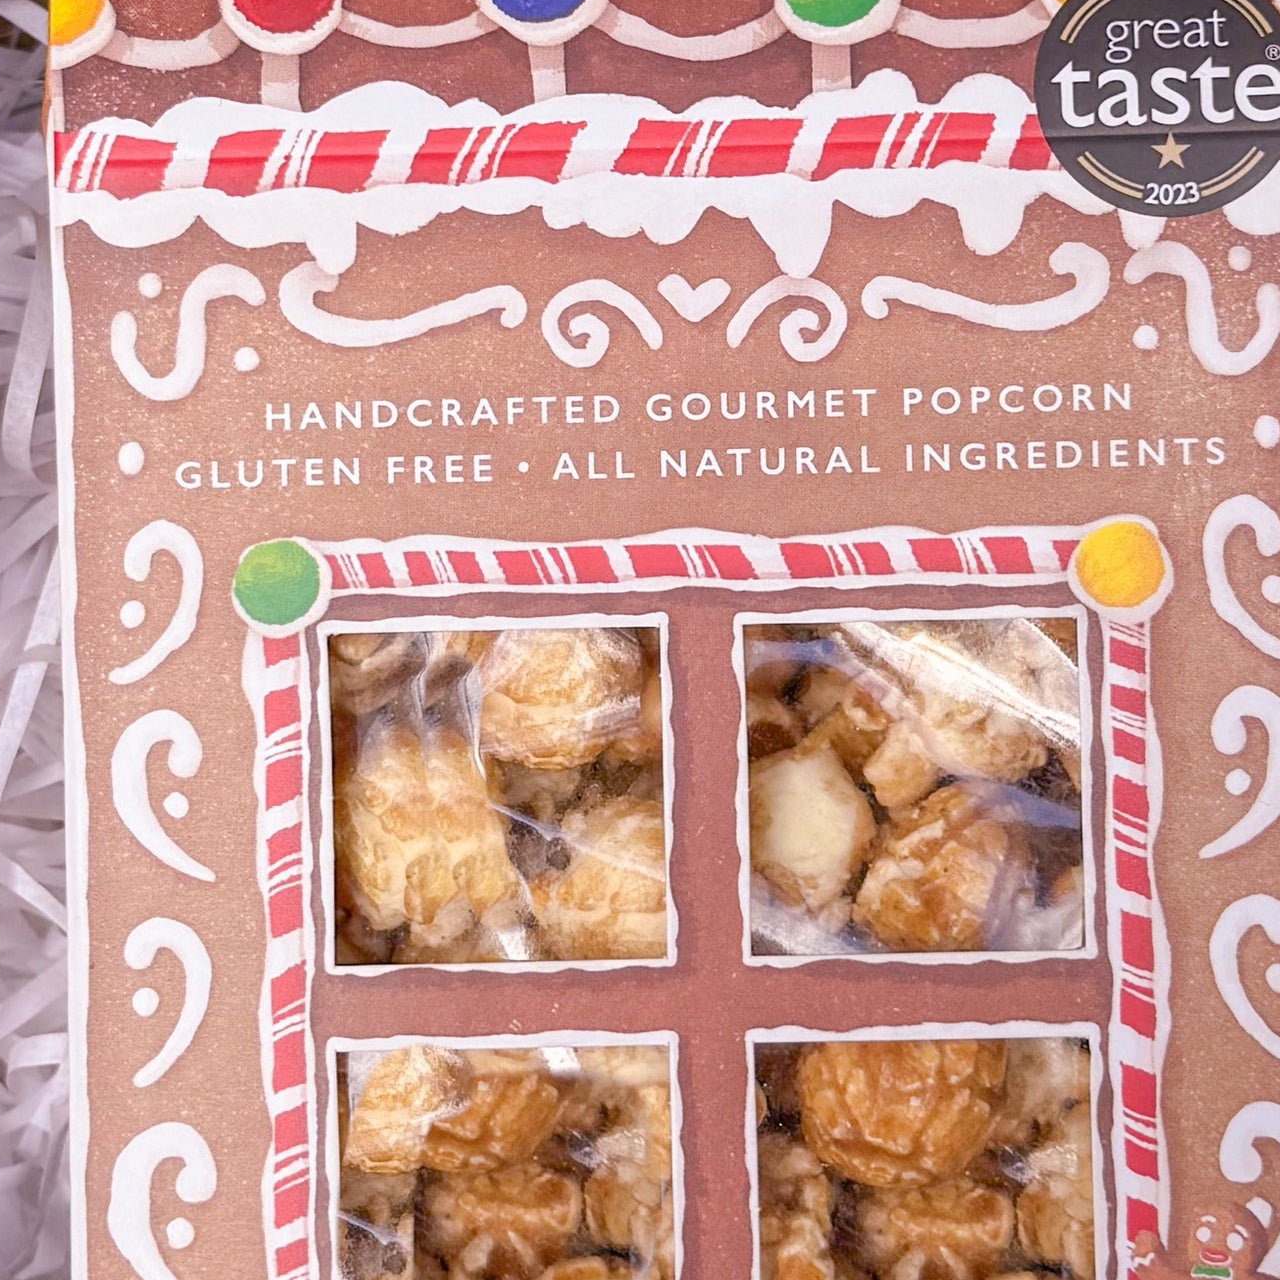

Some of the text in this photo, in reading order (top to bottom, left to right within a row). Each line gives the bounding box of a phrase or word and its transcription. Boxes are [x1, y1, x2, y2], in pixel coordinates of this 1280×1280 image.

[1105, 9, 1229, 64] great
[1143, 181, 1201, 206] 2023
[264, 382, 1132, 432] HANDCRAFTED GOURMET POPCORN
[174, 436, 1226, 490] GLUTEN FREE ALL NATURAL INGREDIENTS
